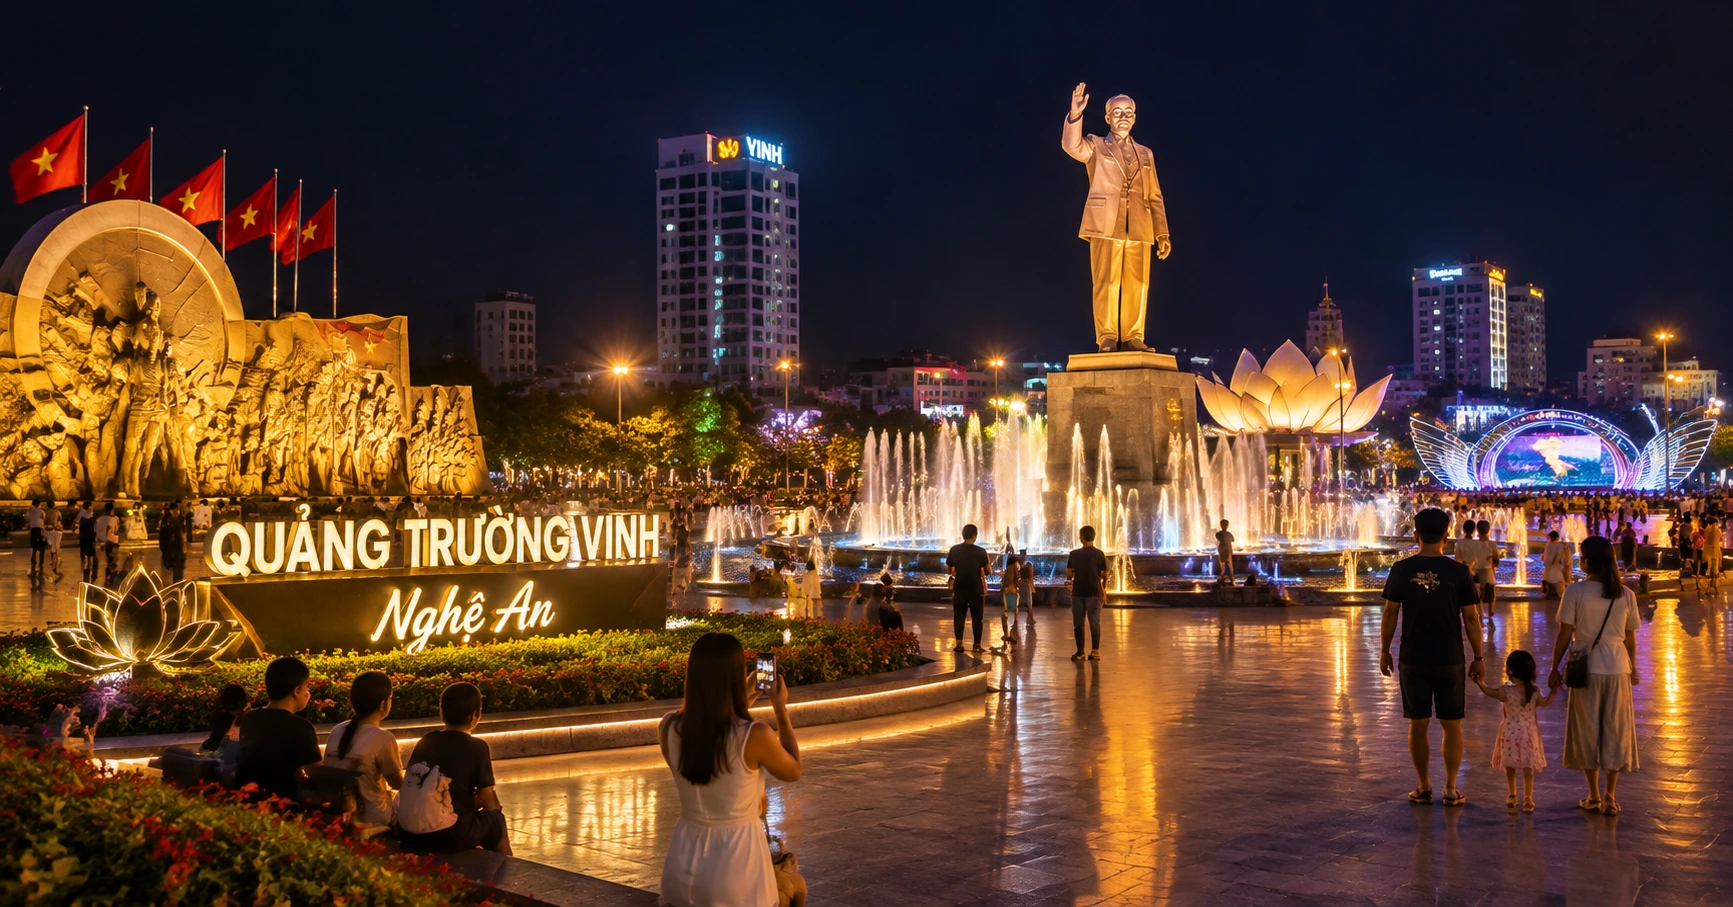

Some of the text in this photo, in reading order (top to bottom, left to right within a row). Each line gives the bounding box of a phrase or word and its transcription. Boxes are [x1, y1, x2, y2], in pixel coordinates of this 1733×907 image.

[746, 136, 783, 165] VINH
[209, 503, 660, 577] QUẢNG TRƯỜNG VINH
[370, 580, 556, 656] Nghệ An
